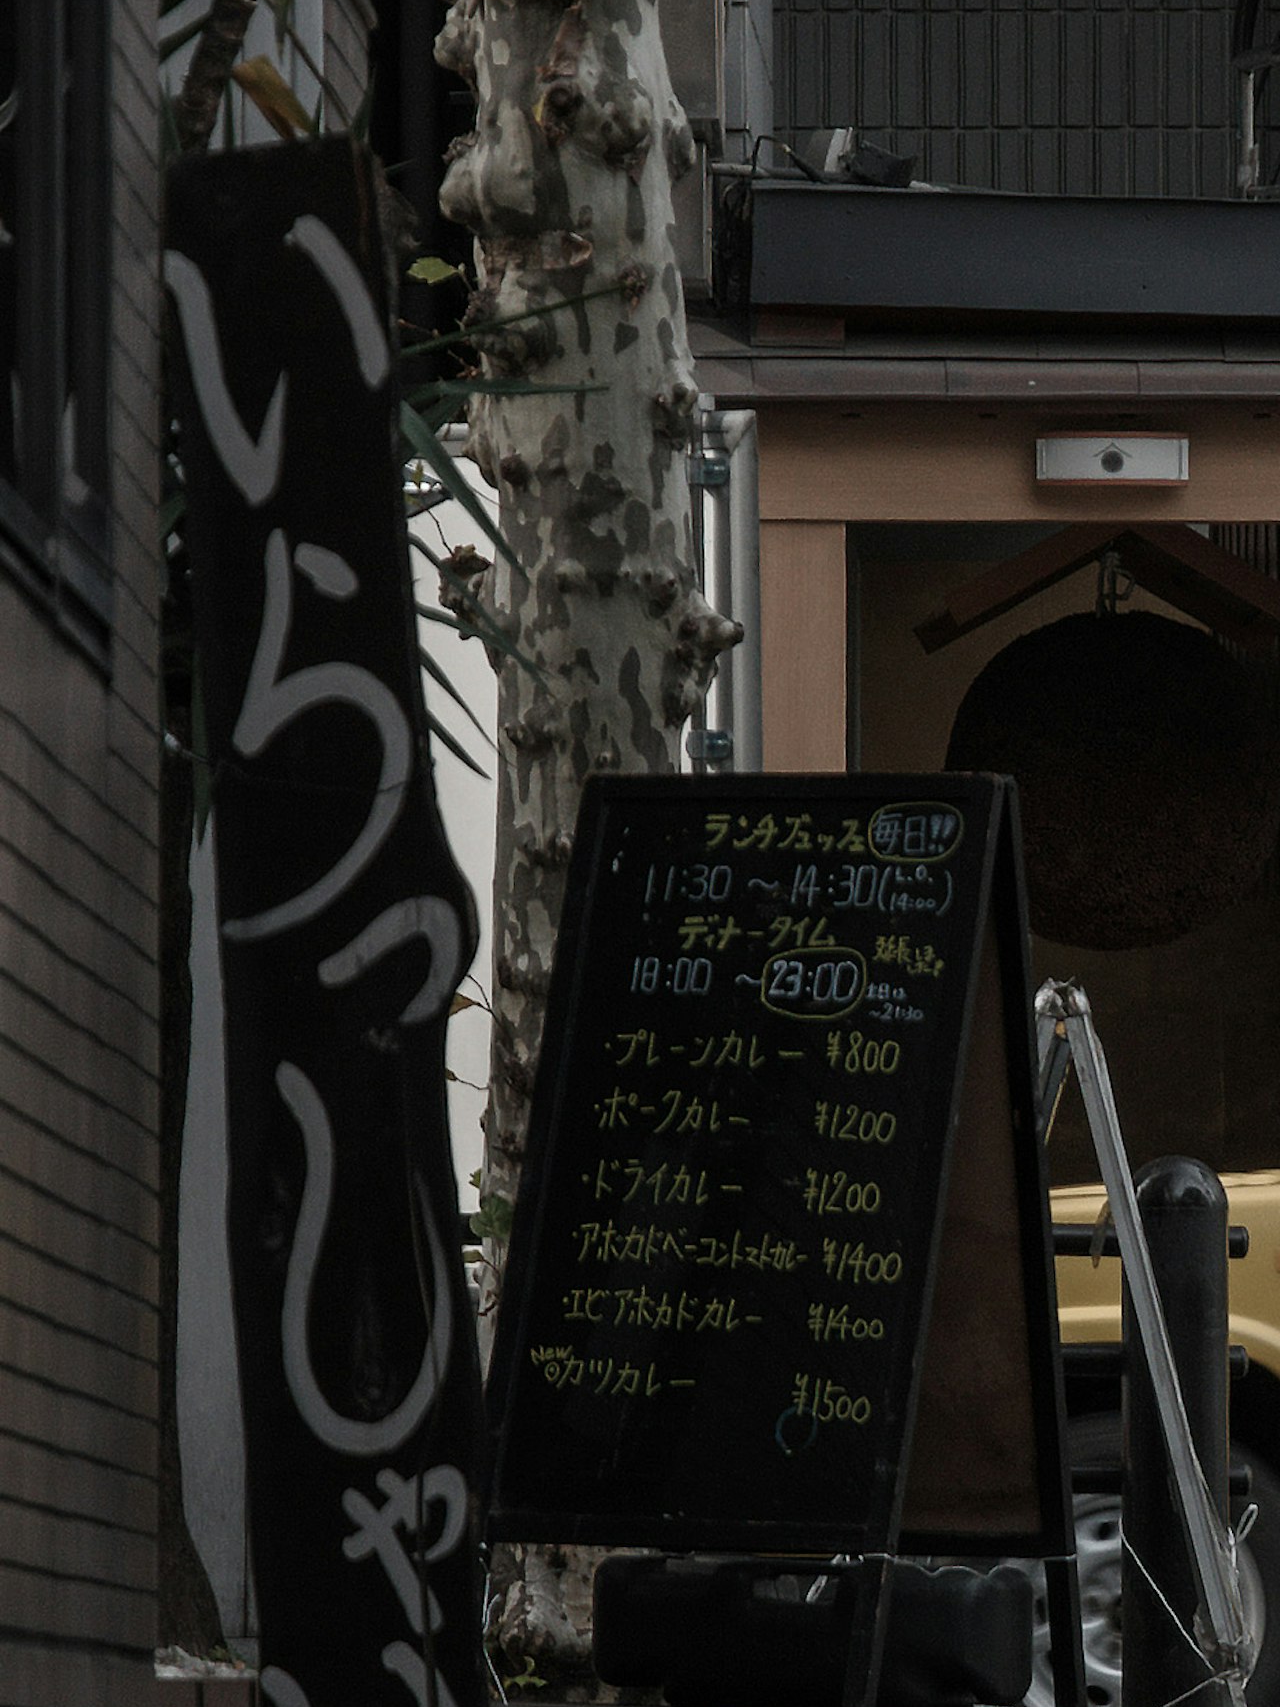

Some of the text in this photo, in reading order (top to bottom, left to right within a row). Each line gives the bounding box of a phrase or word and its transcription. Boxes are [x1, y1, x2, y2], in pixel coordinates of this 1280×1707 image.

[678, 915, 835, 950] ディナータイム
[826, 1030, 901, 1074] ¥800
[814, 1100, 897, 1143] ¥1200
[803, 1167, 881, 1214] ¥1200
[821, 1236, 904, 1284] ¥1400
[807, 1302, 884, 1341] ¥1400
[530, 1344, 574, 1365] New
[791, 1371, 874, 1425] ¥1500
